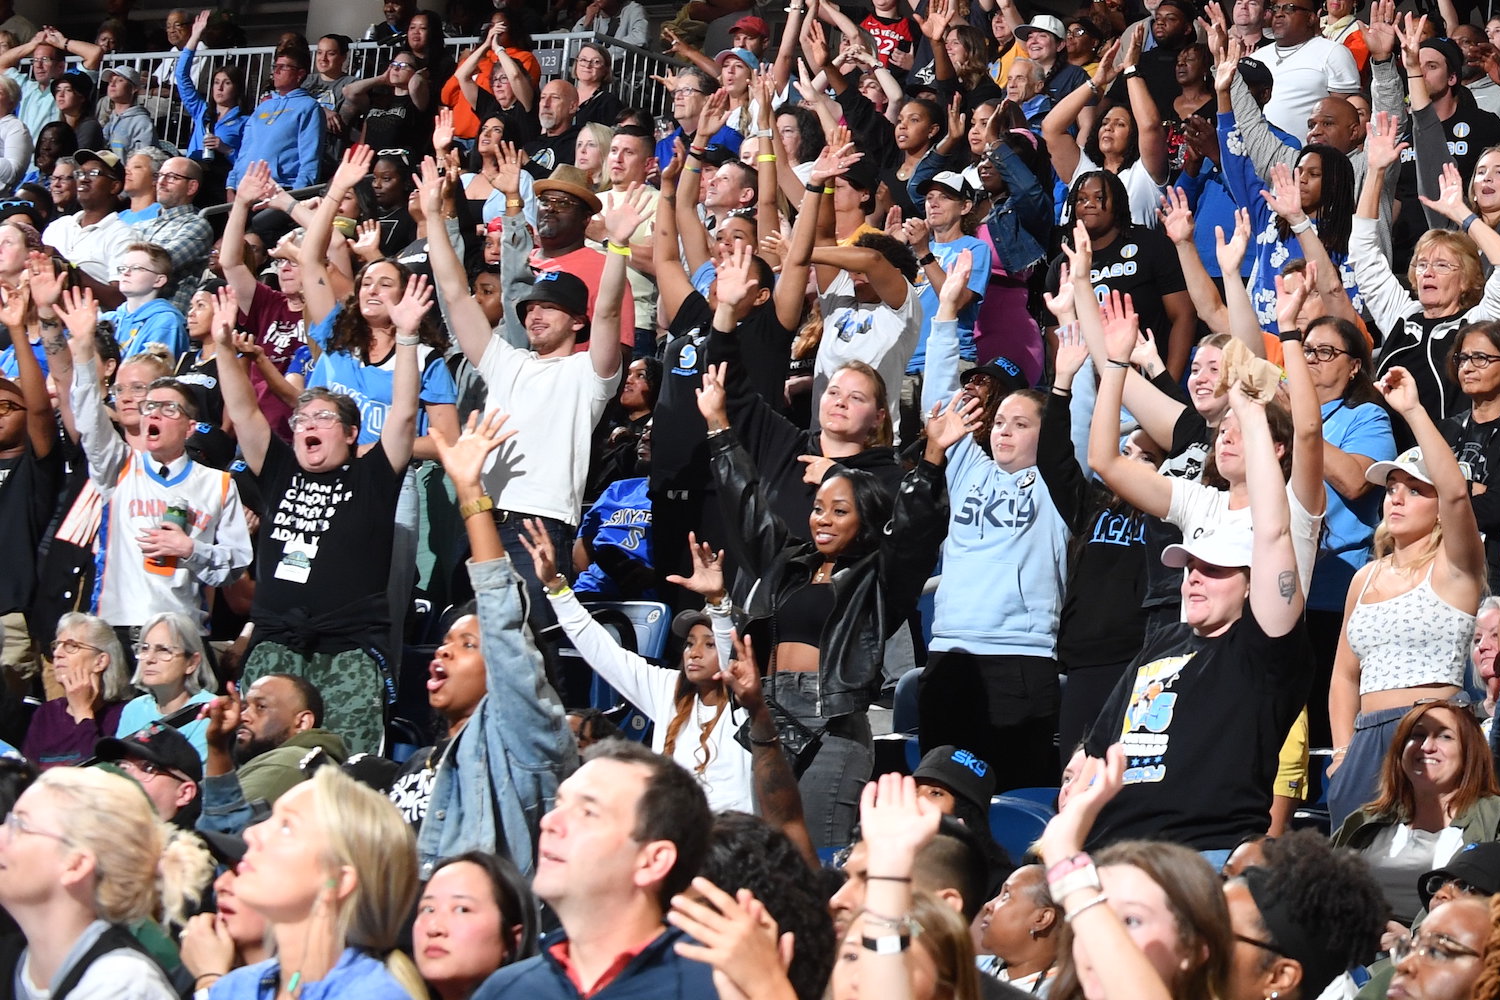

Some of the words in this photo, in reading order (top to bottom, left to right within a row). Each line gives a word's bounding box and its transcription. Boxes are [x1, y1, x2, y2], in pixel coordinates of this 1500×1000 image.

[541, 56, 556, 67] 123
[953, 496, 1037, 529] SKY
[951, 750, 989, 777] SKY
